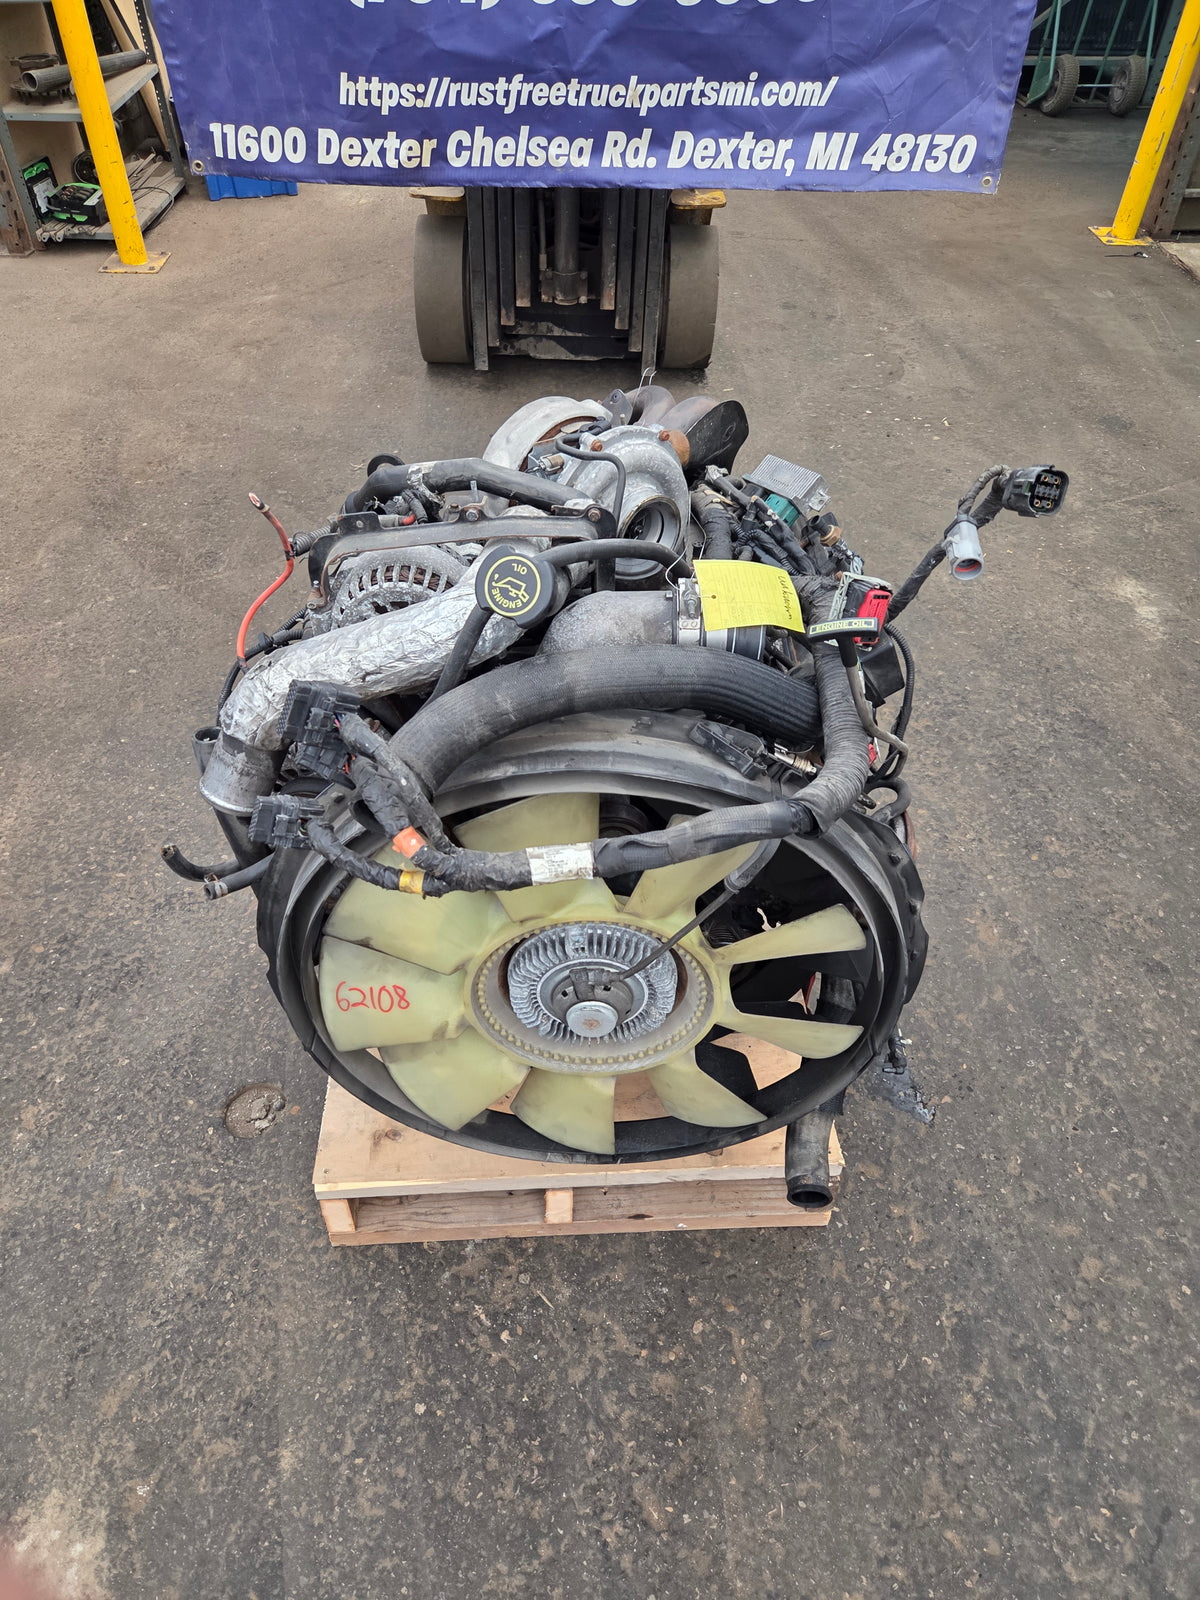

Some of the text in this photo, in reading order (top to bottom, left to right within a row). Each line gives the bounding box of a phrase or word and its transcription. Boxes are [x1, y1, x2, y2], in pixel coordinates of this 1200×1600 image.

[339, 72, 839, 116] https://rustfreetruckpartsmi.com/
[209, 122, 978, 177] 11600 Dexter Chelsea Rd. Dexter, MI 48130
[511, 562, 528, 575] OIL
[491, 587, 523, 609] ENGINE
[816, 619, 868, 633] ENGINE OIL
[335, 980, 411, 1013] 62108
